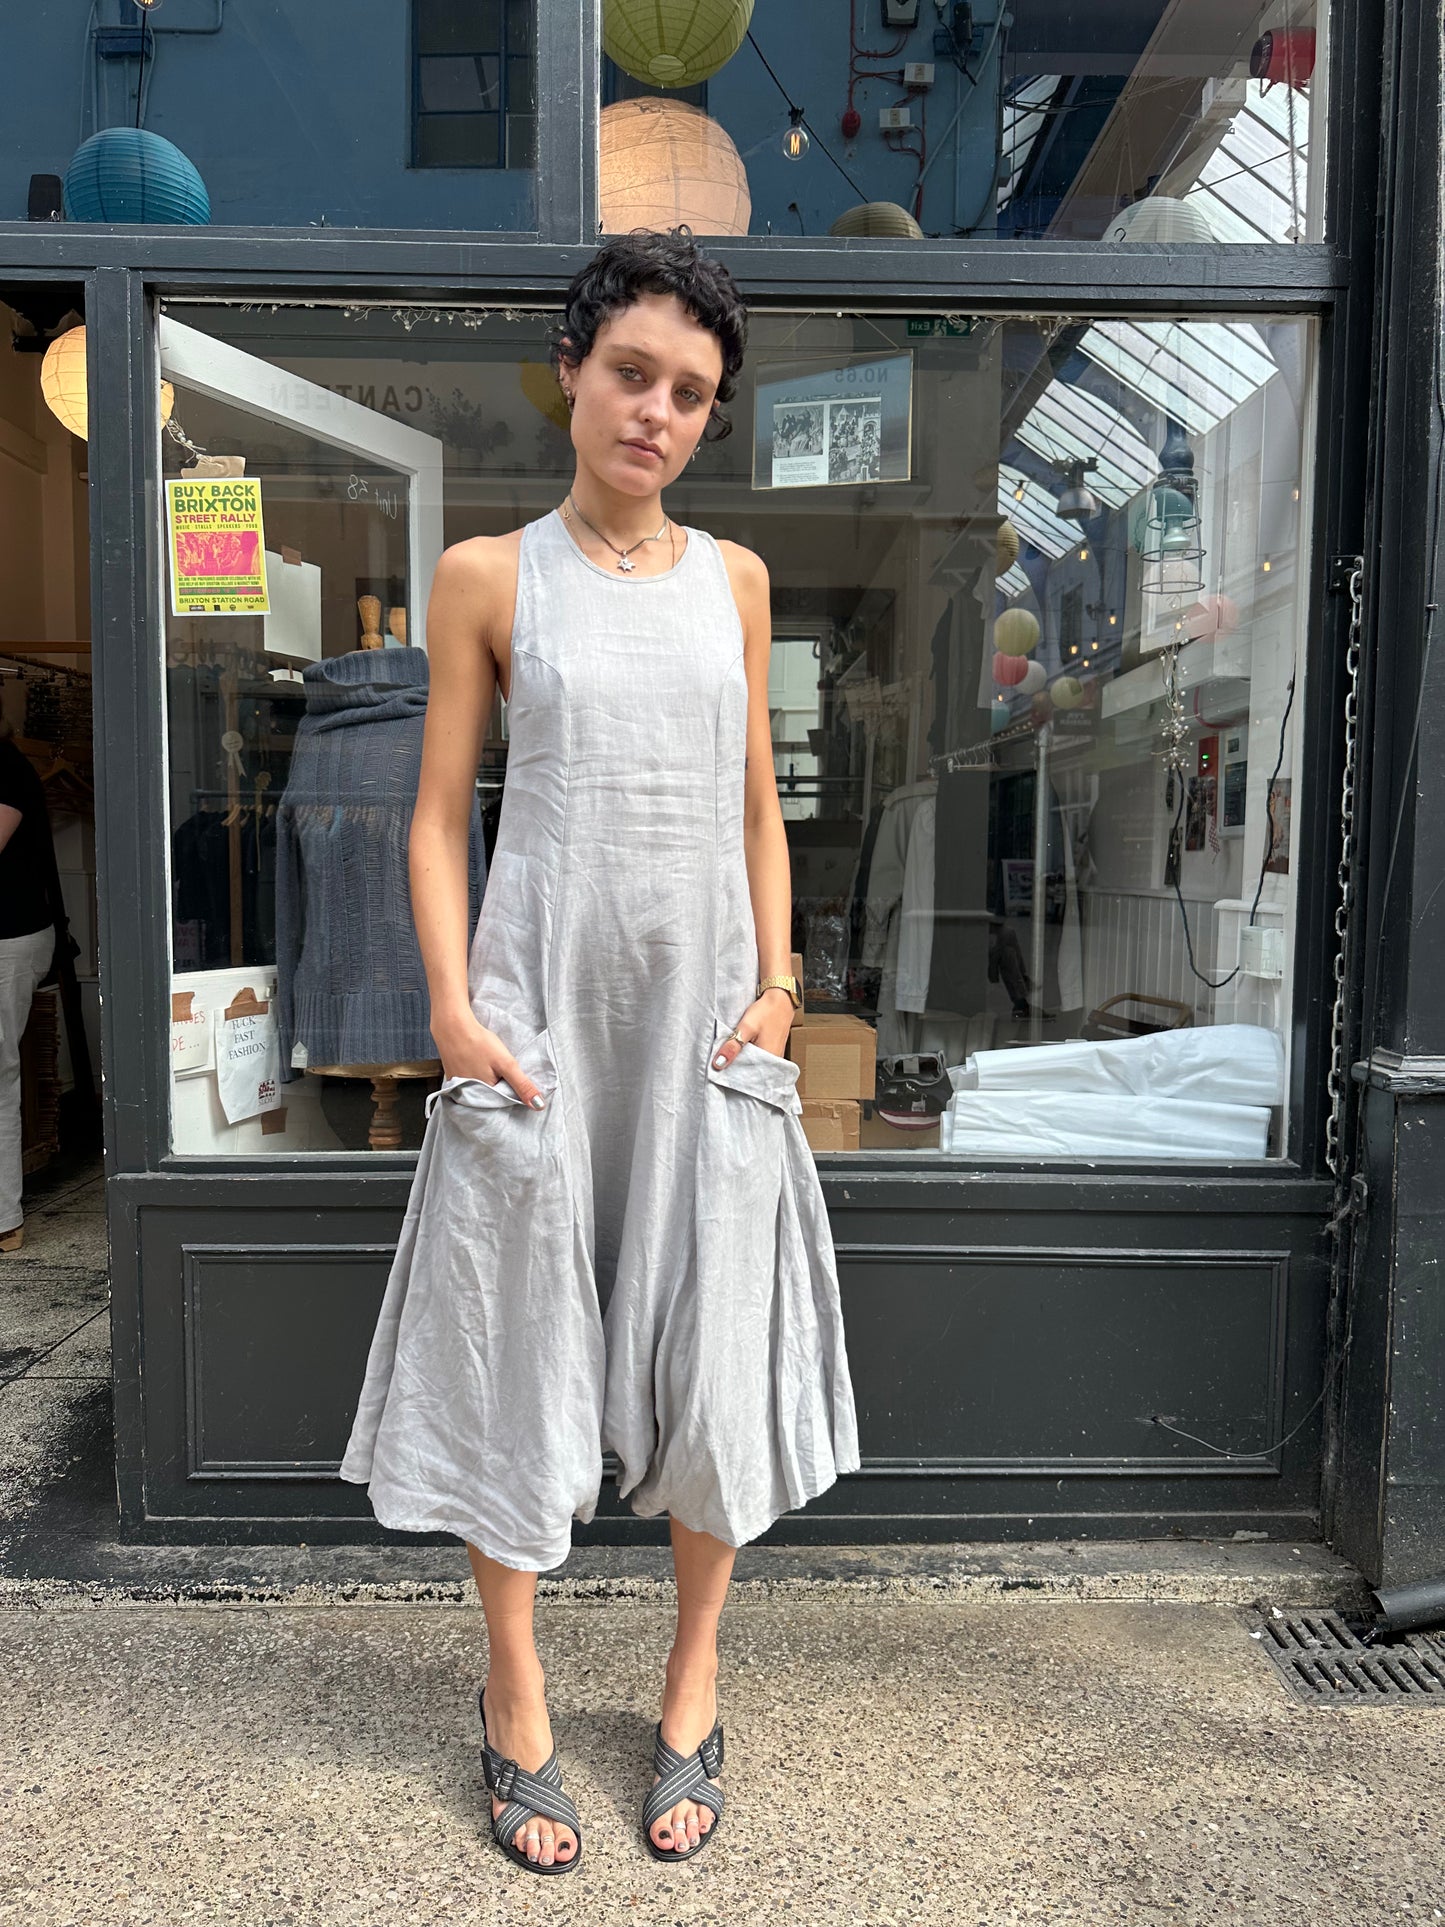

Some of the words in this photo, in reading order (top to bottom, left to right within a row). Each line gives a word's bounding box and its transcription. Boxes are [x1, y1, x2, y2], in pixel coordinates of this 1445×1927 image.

[174, 486, 206, 498] BUY
[212, 485, 255, 497] BACK
[175, 498, 256, 513] BRIXTON
[175, 514, 217, 524] STREET
[221, 513, 256, 523] RALLY
[232, 1015, 256, 1030] FUCK
[234, 1029, 255, 1044] FAST
[228, 1041, 266, 1060] FASHION
